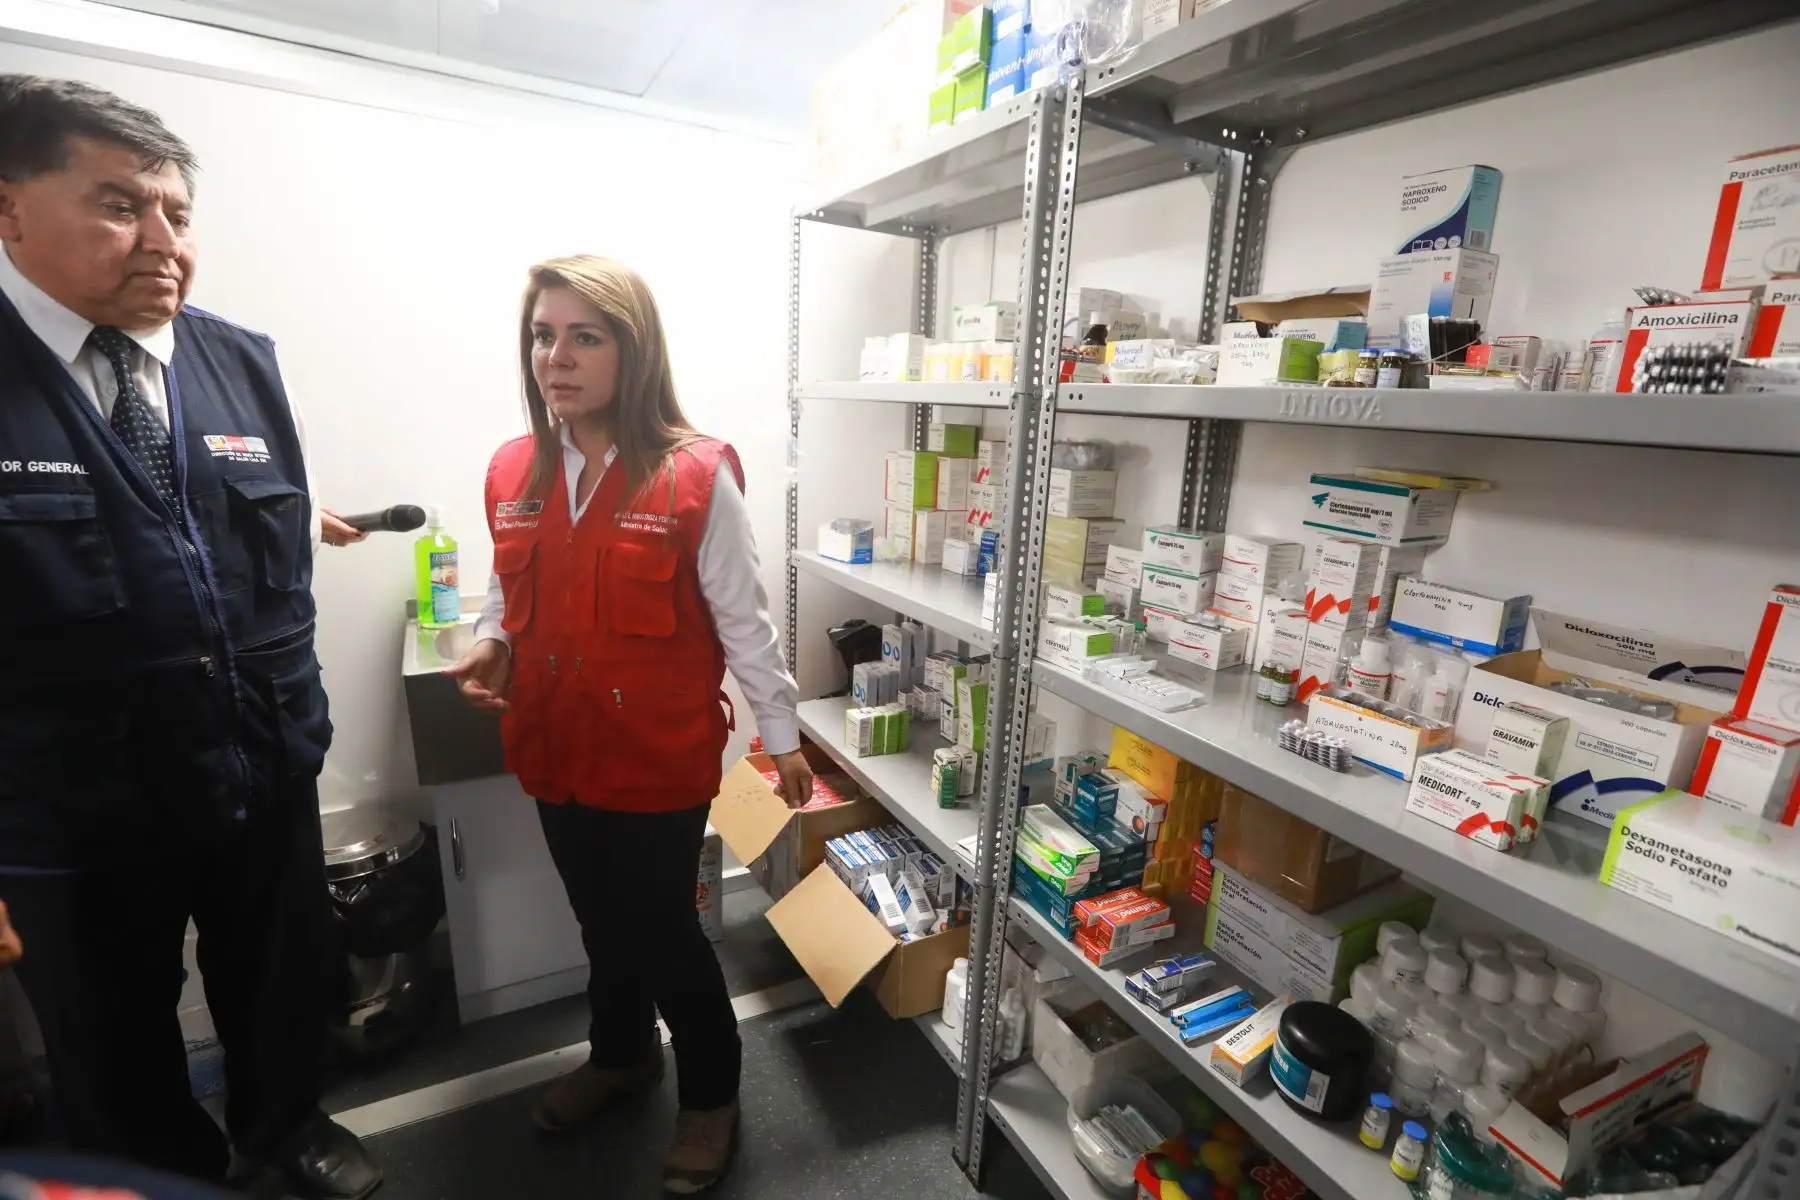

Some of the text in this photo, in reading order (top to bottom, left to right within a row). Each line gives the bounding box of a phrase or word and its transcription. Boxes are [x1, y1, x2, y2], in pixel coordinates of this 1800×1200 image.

[1403, 185, 1447, 198] NAPROXENO
[1638, 312, 1739, 327] Amoxicilina
[1280, 392, 1382, 420] INNOVA
[28, 461, 91, 474] GENERAL
[1565, 623, 1654, 648] Dicloxacilina
[1616, 643, 1656, 656] 500 mg
[1492, 729, 1535, 749] GRAVAMIN
[1715, 730, 1778, 755] Dicloxacilina
[1418, 775, 1464, 800] MEDICORT
[1471, 799, 1481, 809] mg
[1621, 825, 1732, 877] Dexametasona
[1625, 840, 1665, 864] Sodio
[1669, 858, 1728, 889] Fosfato
[1220, 887, 1235, 900] Oral
[1222, 875, 1249, 895] Sales de
[1215, 931, 1230, 945] Oral
[1217, 919, 1245, 941] Sales de
[1225, 1023, 1256, 1048] DESTOLIT
